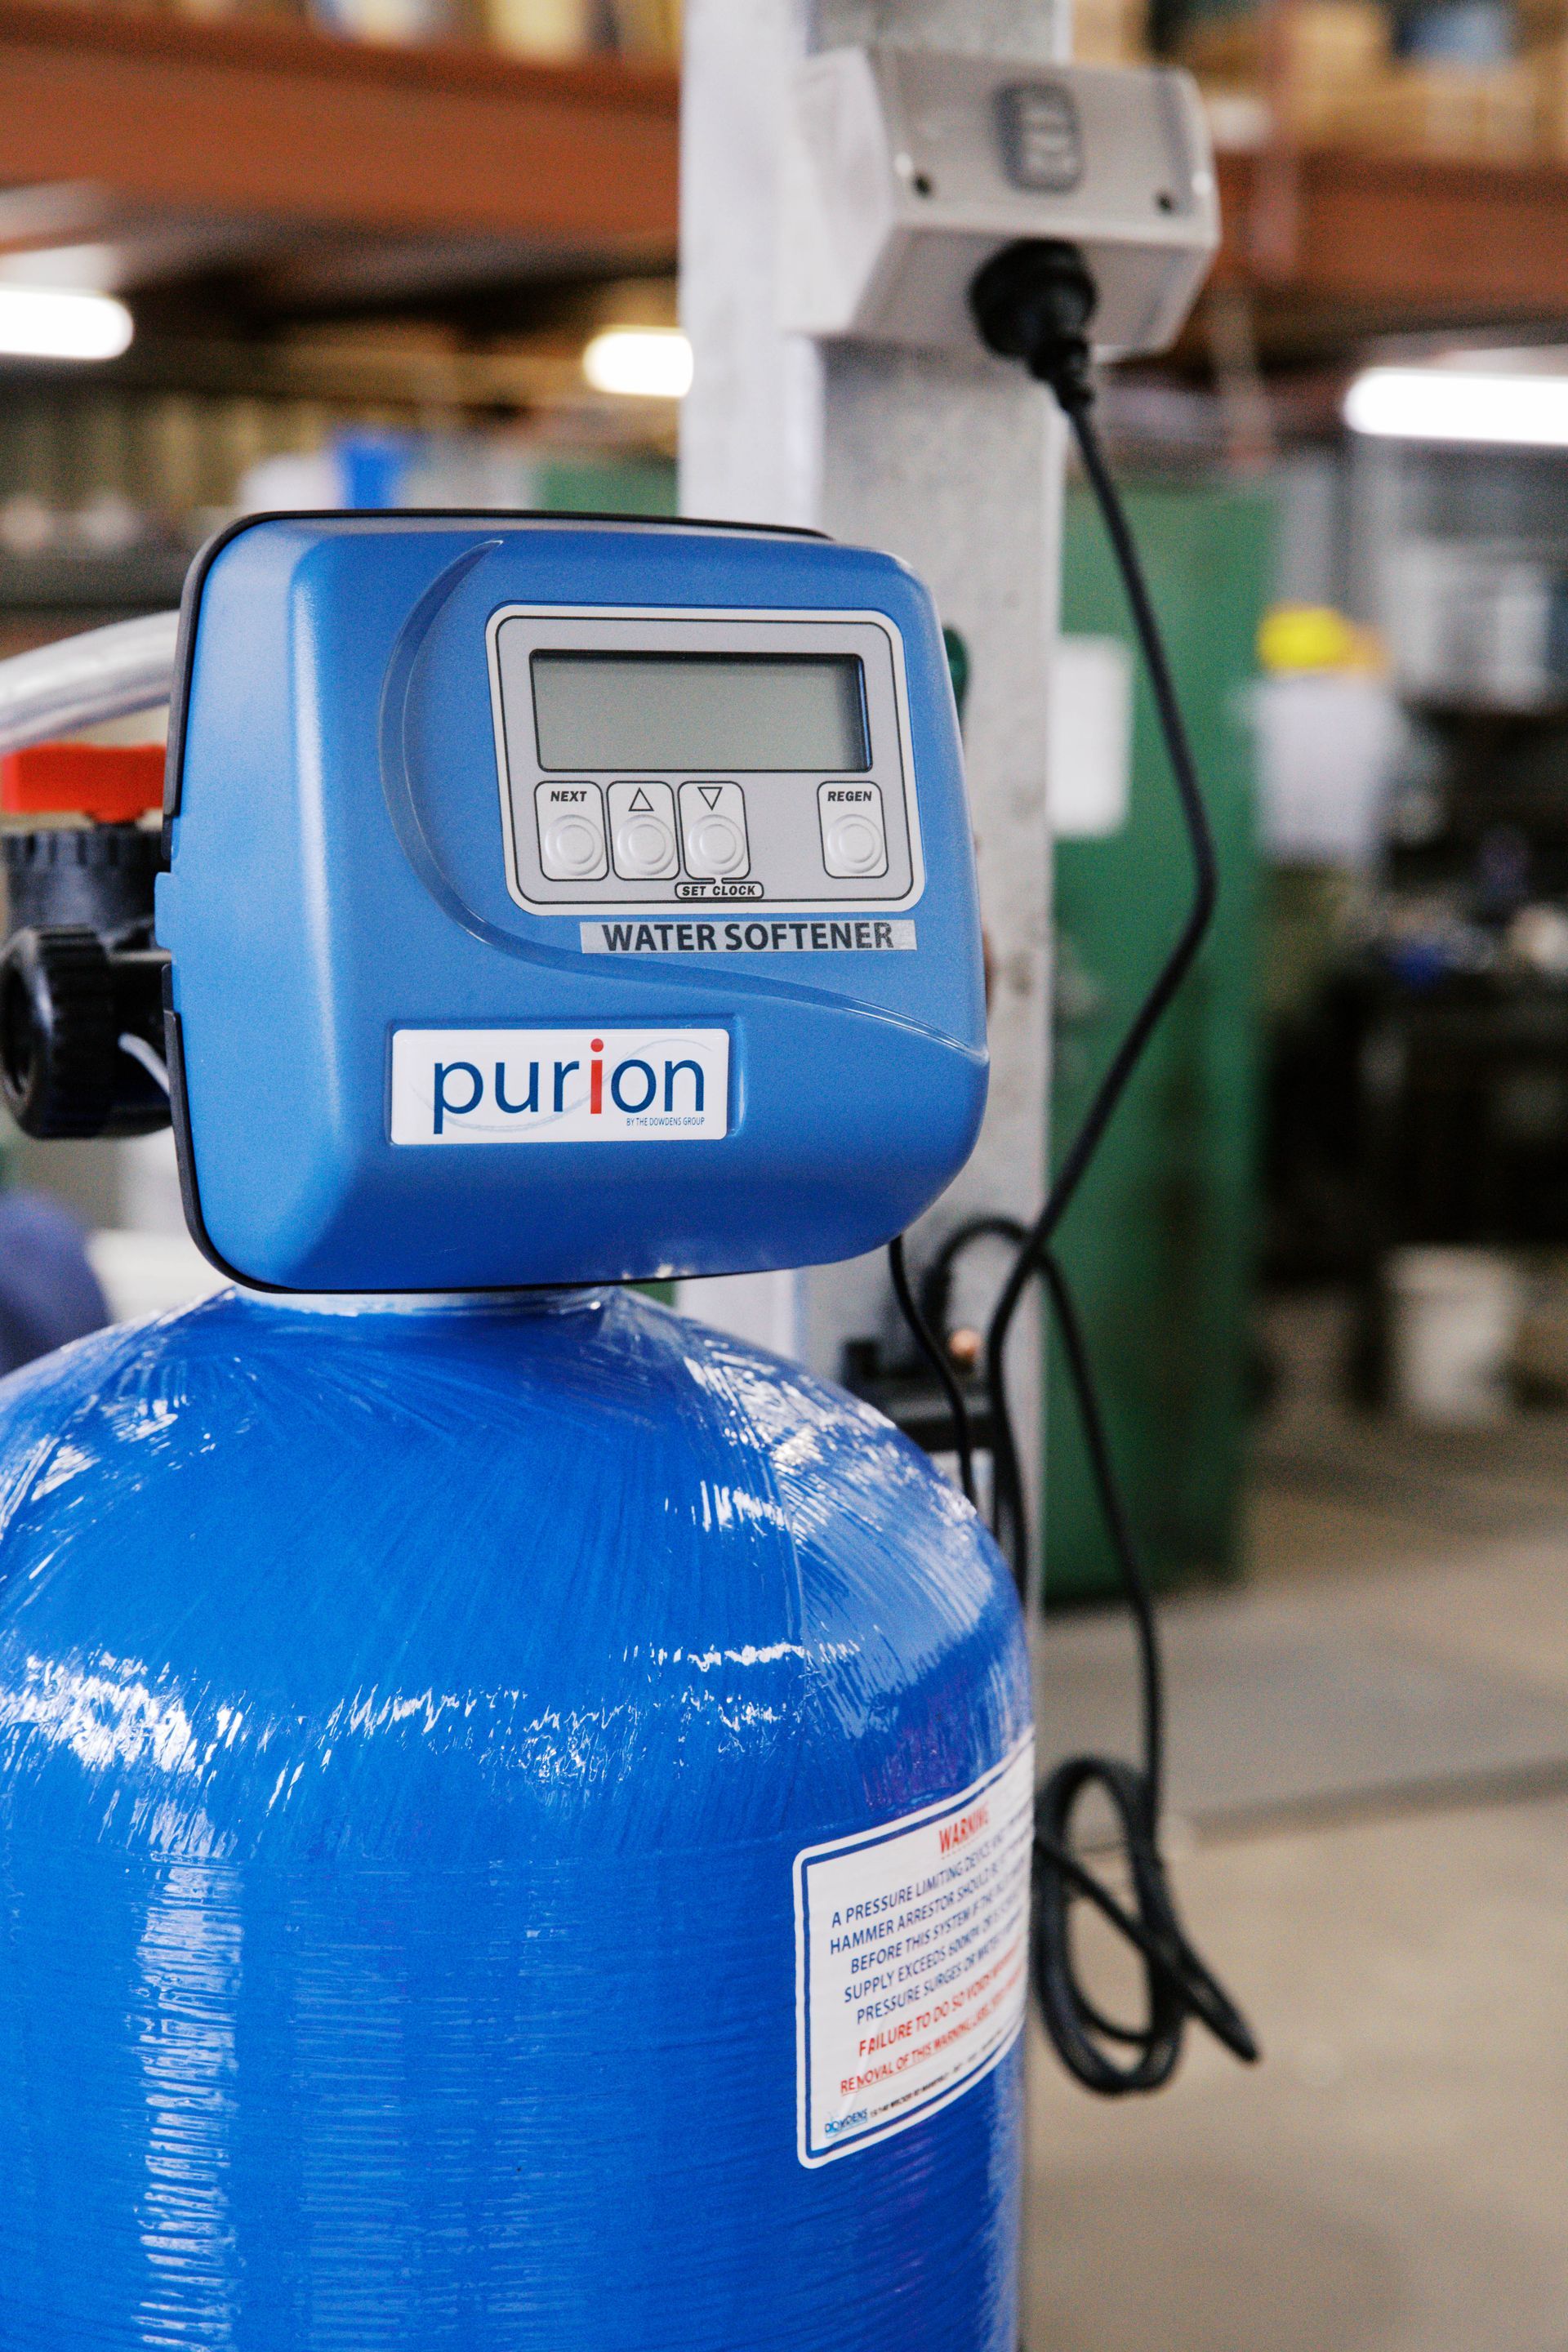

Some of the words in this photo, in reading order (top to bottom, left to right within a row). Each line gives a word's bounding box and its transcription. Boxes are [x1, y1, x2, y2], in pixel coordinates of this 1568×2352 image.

[550, 790, 587, 803] NEXT
[827, 791, 872, 802] REGEN
[682, 885, 706, 897] SET
[712, 884, 756, 897] CLOCK
[602, 923, 715, 952] WATER
[725, 922, 894, 951] SOFTENER
[433, 1038, 704, 1134] purion
[626, 1117, 635, 1126] BY
[636, 1117, 648, 1126] THE
[649, 1117, 682, 1126] DOWDENS
[684, 1116, 705, 1125] GROUP
[831, 1911, 841, 1928] A
[846, 1885, 912, 1923] PRESSURE
[915, 1860, 962, 1896] LIMITING
[831, 1919, 893, 1955] HAMMER
[898, 1891, 954, 1931] ARRESTOR
[851, 1941, 902, 1975] BEFORE
[906, 1928, 930, 1953] THIS
[933, 1906, 969, 1941] SYSTEM
[844, 1971, 894, 2003] SUPPLY
[898, 1944, 946, 1983] EXCEEDS
[858, 1985, 920, 2025] PRESSURE
[924, 1962, 961, 1997] SURGES
[859, 2020, 912, 2056] FAILURE
[916, 2011, 930, 2032] TO
[933, 2001, 949, 2022] DO
[896, 2053, 909, 2070] OF
